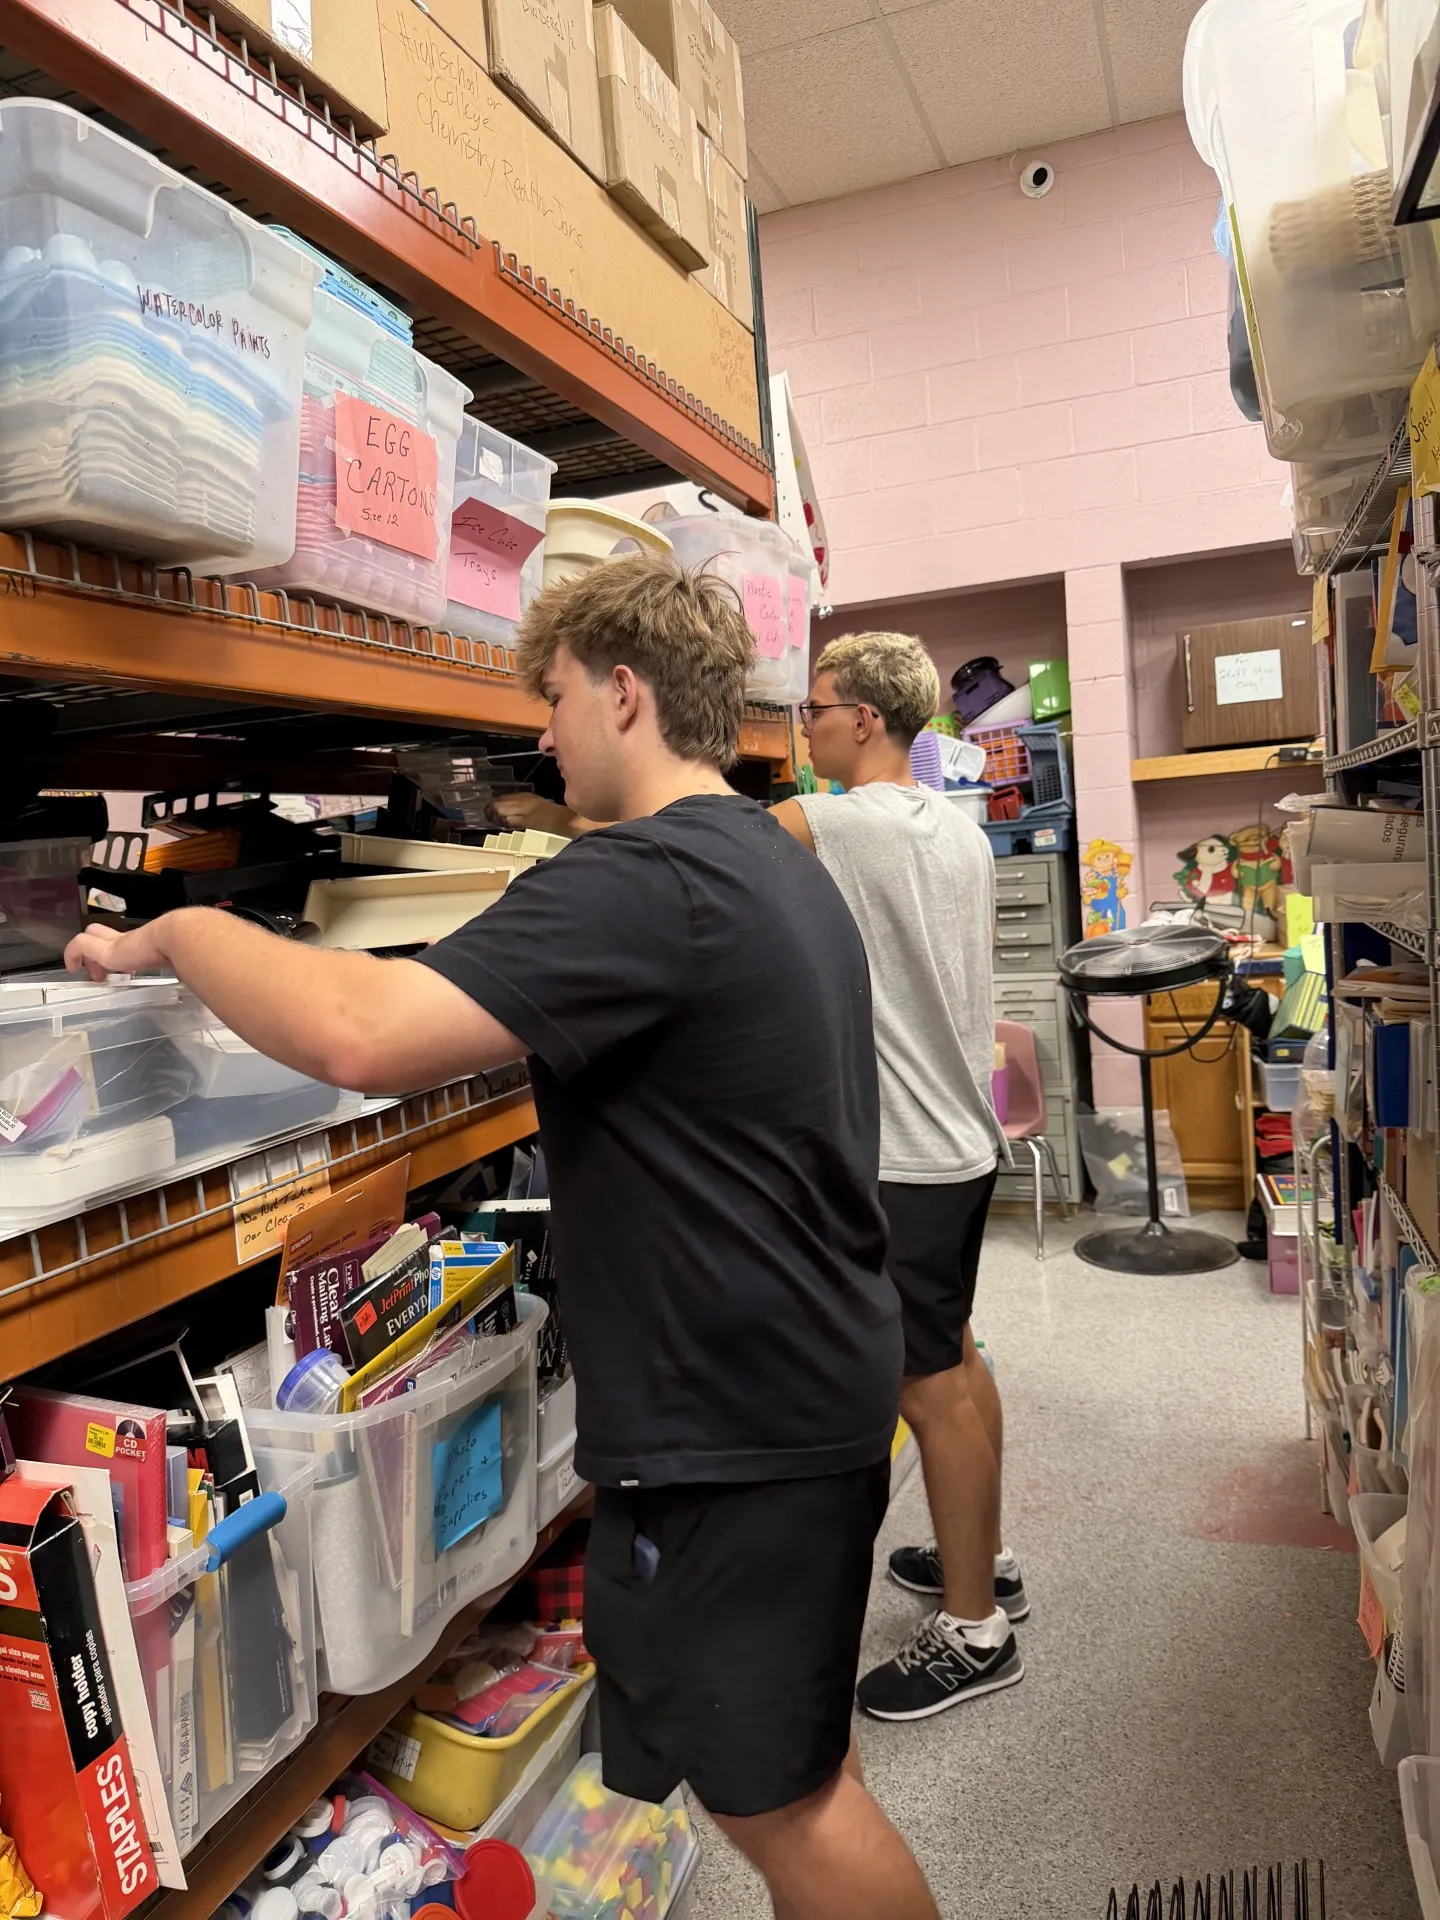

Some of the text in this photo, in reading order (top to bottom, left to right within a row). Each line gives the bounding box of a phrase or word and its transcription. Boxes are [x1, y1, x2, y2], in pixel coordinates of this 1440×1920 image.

[486, 96, 502, 111] or
[136, 285, 271, 359] WATERCOLOR PAINTS
[366, 415, 411, 457] EGG
[346, 458, 435, 517] CARTONS
[360, 507, 399, 527] Size 12
[452, 516, 518, 551] Ice Cube
[454, 552, 497, 587] Trays
[240, 1213, 258, 1225] Do
[260, 1197, 279, 1217] Not
[279, 1186, 314, 1205] Take
[318, 1271, 329, 1325] Mailing
[327, 1267, 340, 1320] Clear
[115, 1446, 147, 1458] POCKET
[123, 1438, 138, 1449] CD
[447, 1431, 477, 1464] Photo
[440, 1489, 488, 1534] Supplies
[5, 1665, 45, 1680] viewing area
[22, 1650, 41, 1661] paper
[926, 1650, 974, 1692] N
[71, 1653, 99, 1740] copy holder
[85, 1629, 113, 1727] sujetador para copias
[97, 1753, 148, 1896] STAPLES
